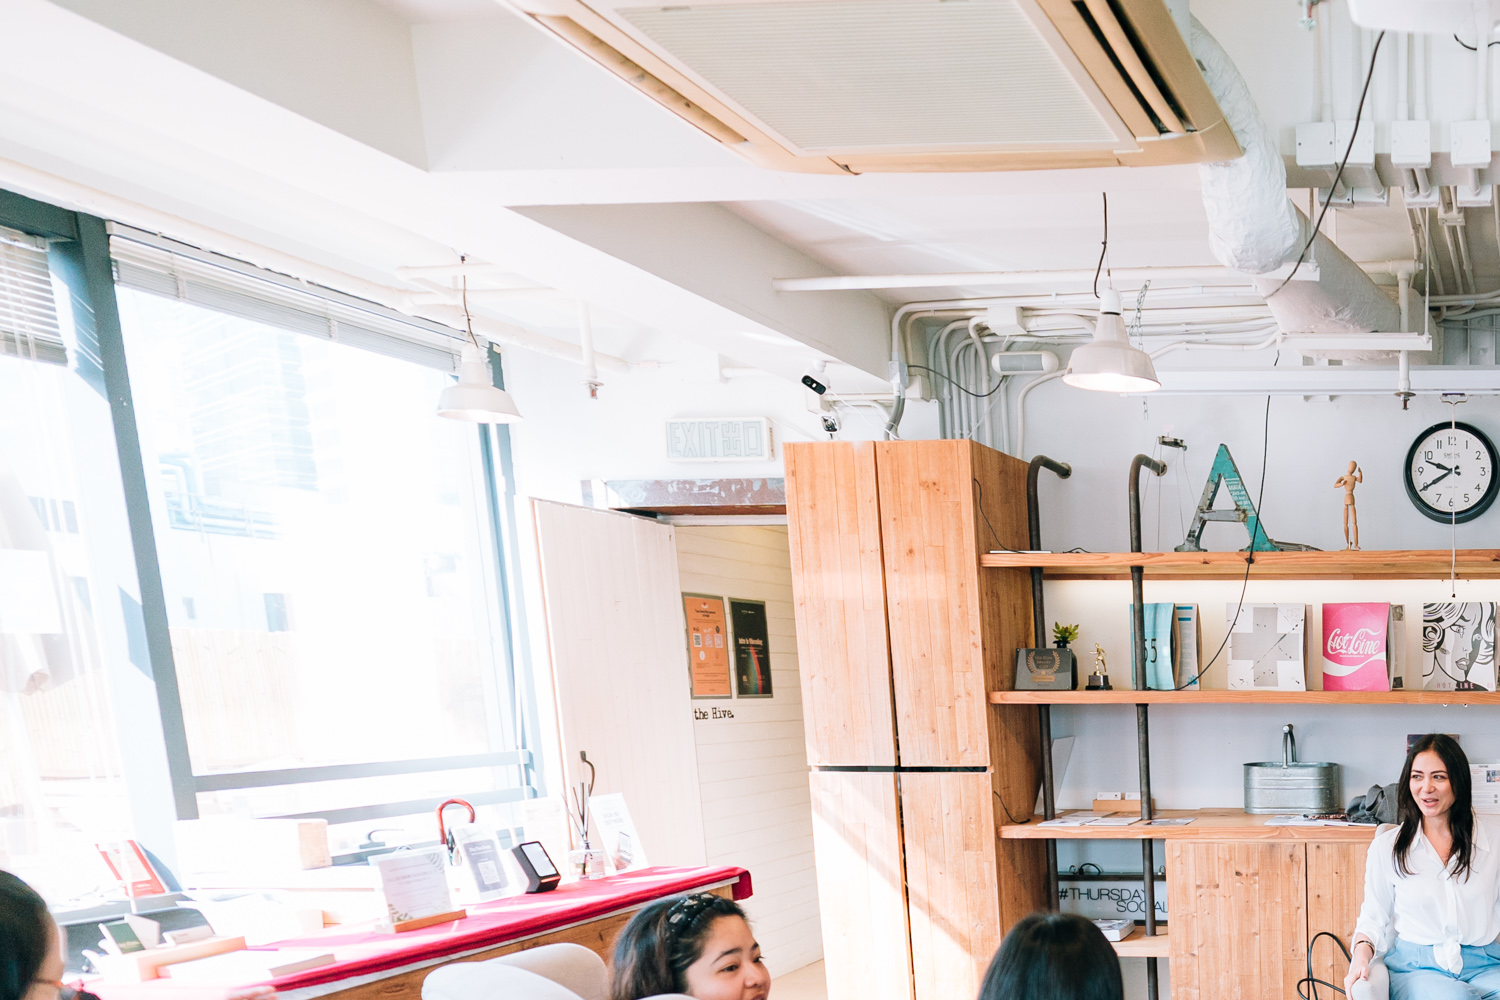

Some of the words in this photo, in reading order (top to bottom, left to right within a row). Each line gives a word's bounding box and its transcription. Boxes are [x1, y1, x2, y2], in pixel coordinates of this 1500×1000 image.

[669, 421, 718, 457] EXIT
[721, 420, 763, 457] 出口
[1436, 440, 1443, 449] 11
[1424, 450, 1434, 460] 10
[1475, 450, 1481, 460] 2
[1417, 466, 1424, 476] 9
[1480, 467, 1486, 476] 3
[1423, 482, 1429, 491] 8
[1474, 483, 1481, 492] 4
[1435, 493, 1442, 503] 7
[1463, 493, 1470, 503] 5
[694, 707, 709, 720] the
[711, 707, 735, 719] Hive.
[1116, 900, 1169, 913] SOCAL
